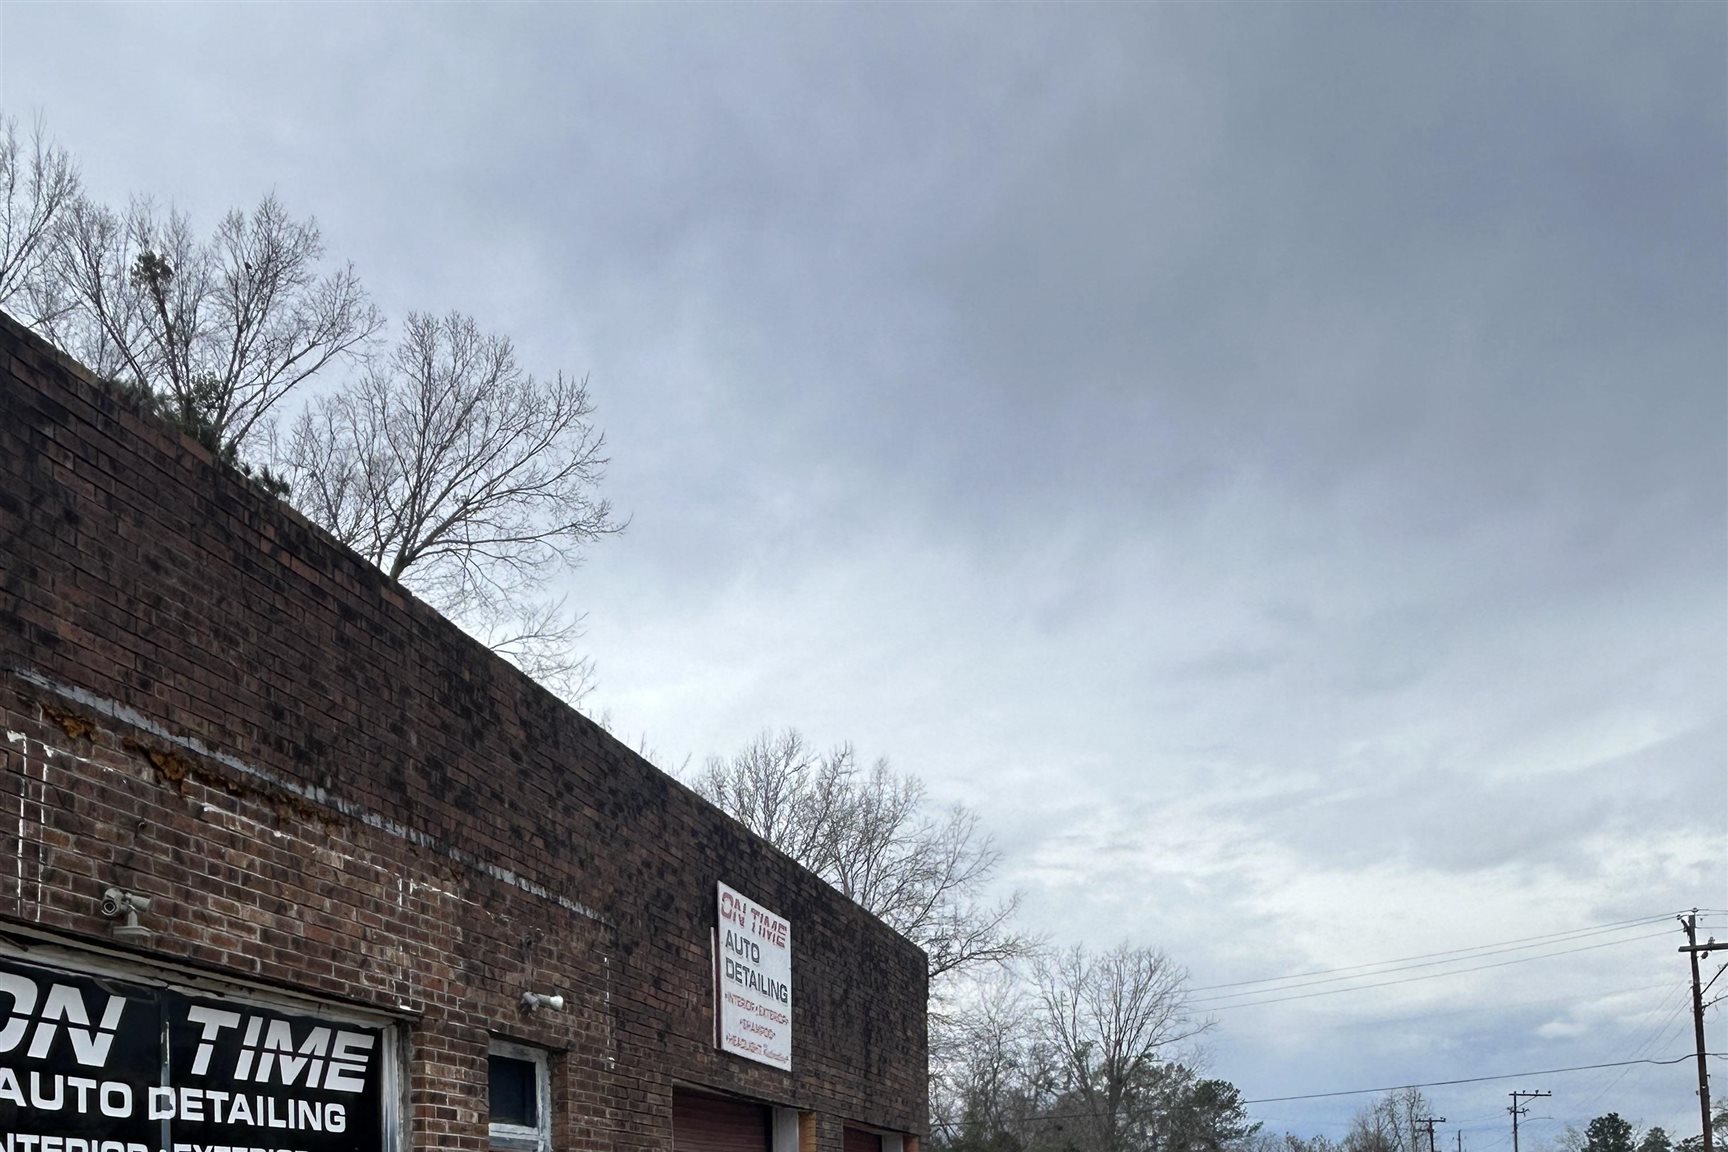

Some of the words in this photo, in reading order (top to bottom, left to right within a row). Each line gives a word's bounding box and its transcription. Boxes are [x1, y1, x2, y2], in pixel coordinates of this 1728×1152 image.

[721, 892, 746, 928] ON
[750, 908, 788, 948] TIME
[725, 929, 760, 964] AUTO
[725, 956, 788, 1003] DETAILING
[187, 1005, 375, 1093] TIME
[0, 1067, 134, 1119] AUTO
[148, 1086, 347, 1134] DETAILING
